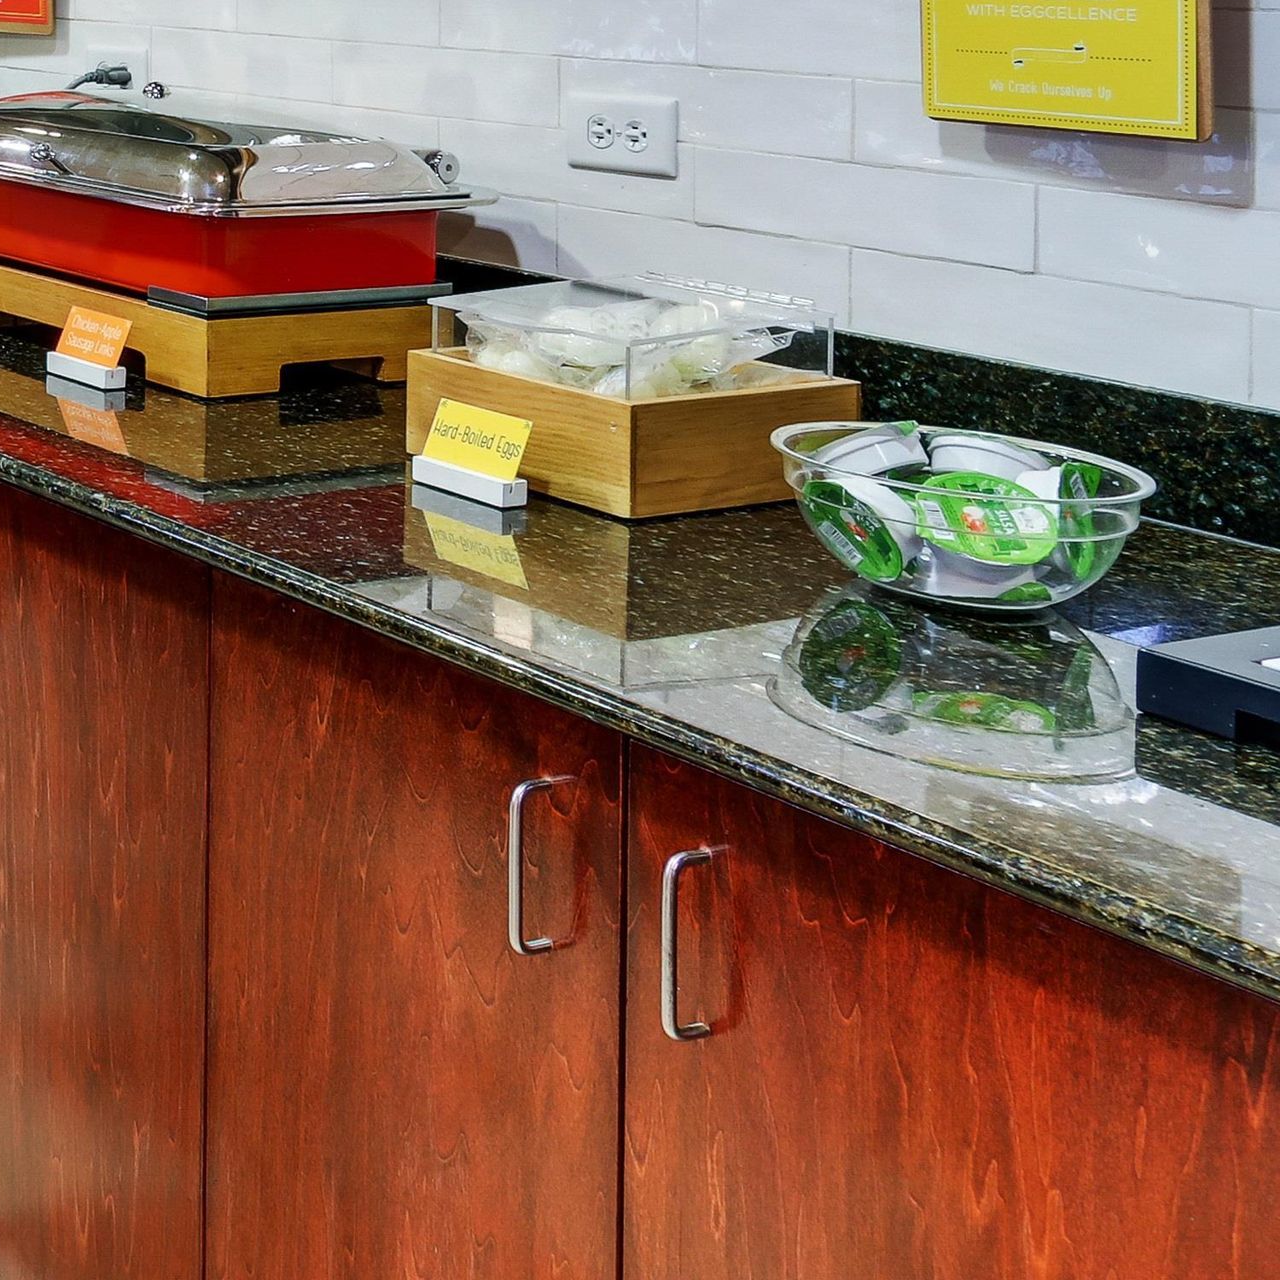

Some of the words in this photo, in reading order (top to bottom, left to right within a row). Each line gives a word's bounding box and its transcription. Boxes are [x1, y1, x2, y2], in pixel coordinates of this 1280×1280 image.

[966, 4, 1005, 17] WITH
[1010, 5, 1137, 22] EGGCELLENCE
[989, 79, 1004, 92] We
[1008, 80, 1038, 94] Crack
[1042, 82, 1093, 98] Ourselves
[1097, 87, 1113, 100] Up
[72, 314, 122, 340] Chicken-Apple
[65, 332, 95, 353] Sausage
[94, 340, 116, 358] Links
[433, 418, 496, 450] Hard-Boiled
[496, 435, 522, 460] Eggs
